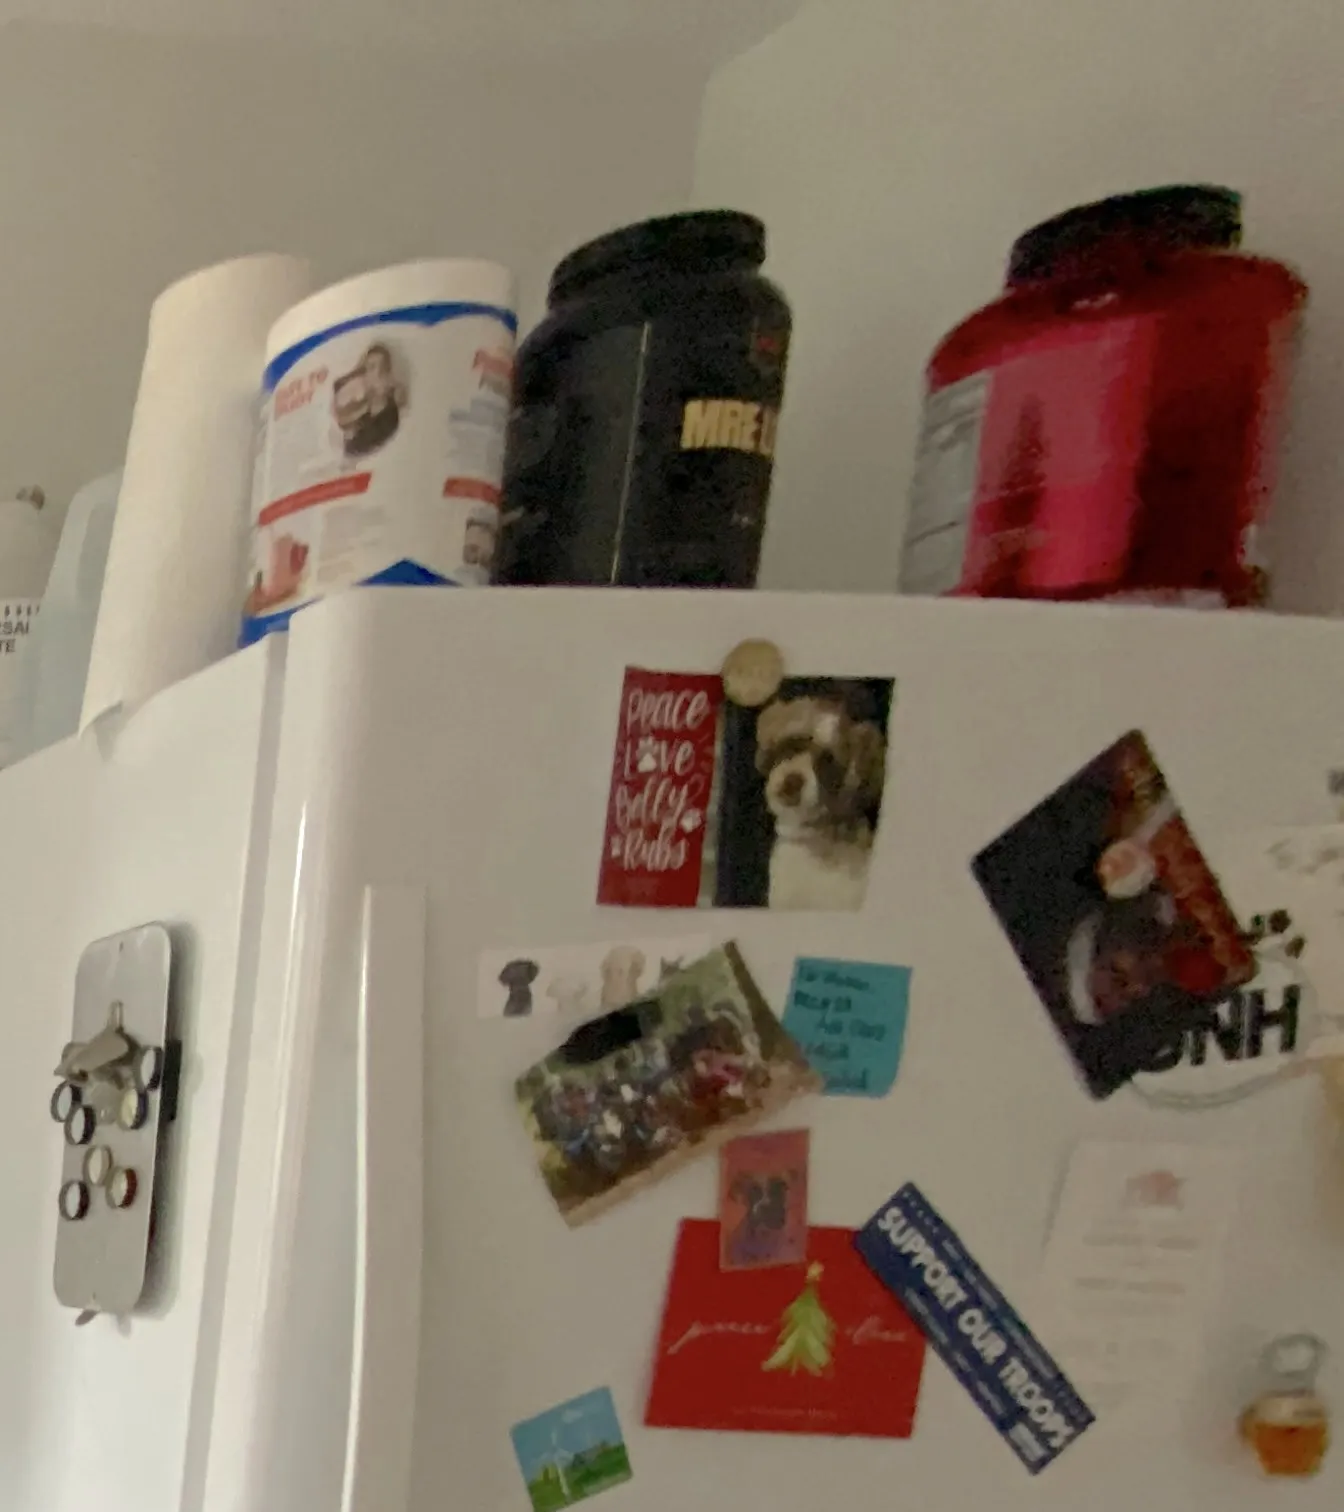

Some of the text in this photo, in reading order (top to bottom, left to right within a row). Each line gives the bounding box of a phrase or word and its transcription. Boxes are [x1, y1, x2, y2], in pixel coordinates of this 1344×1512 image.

[875, 1204, 966, 1317] SUPPORT
[956, 1306, 1008, 1367] OUR
[997, 1356, 1079, 1450] TROOPS
